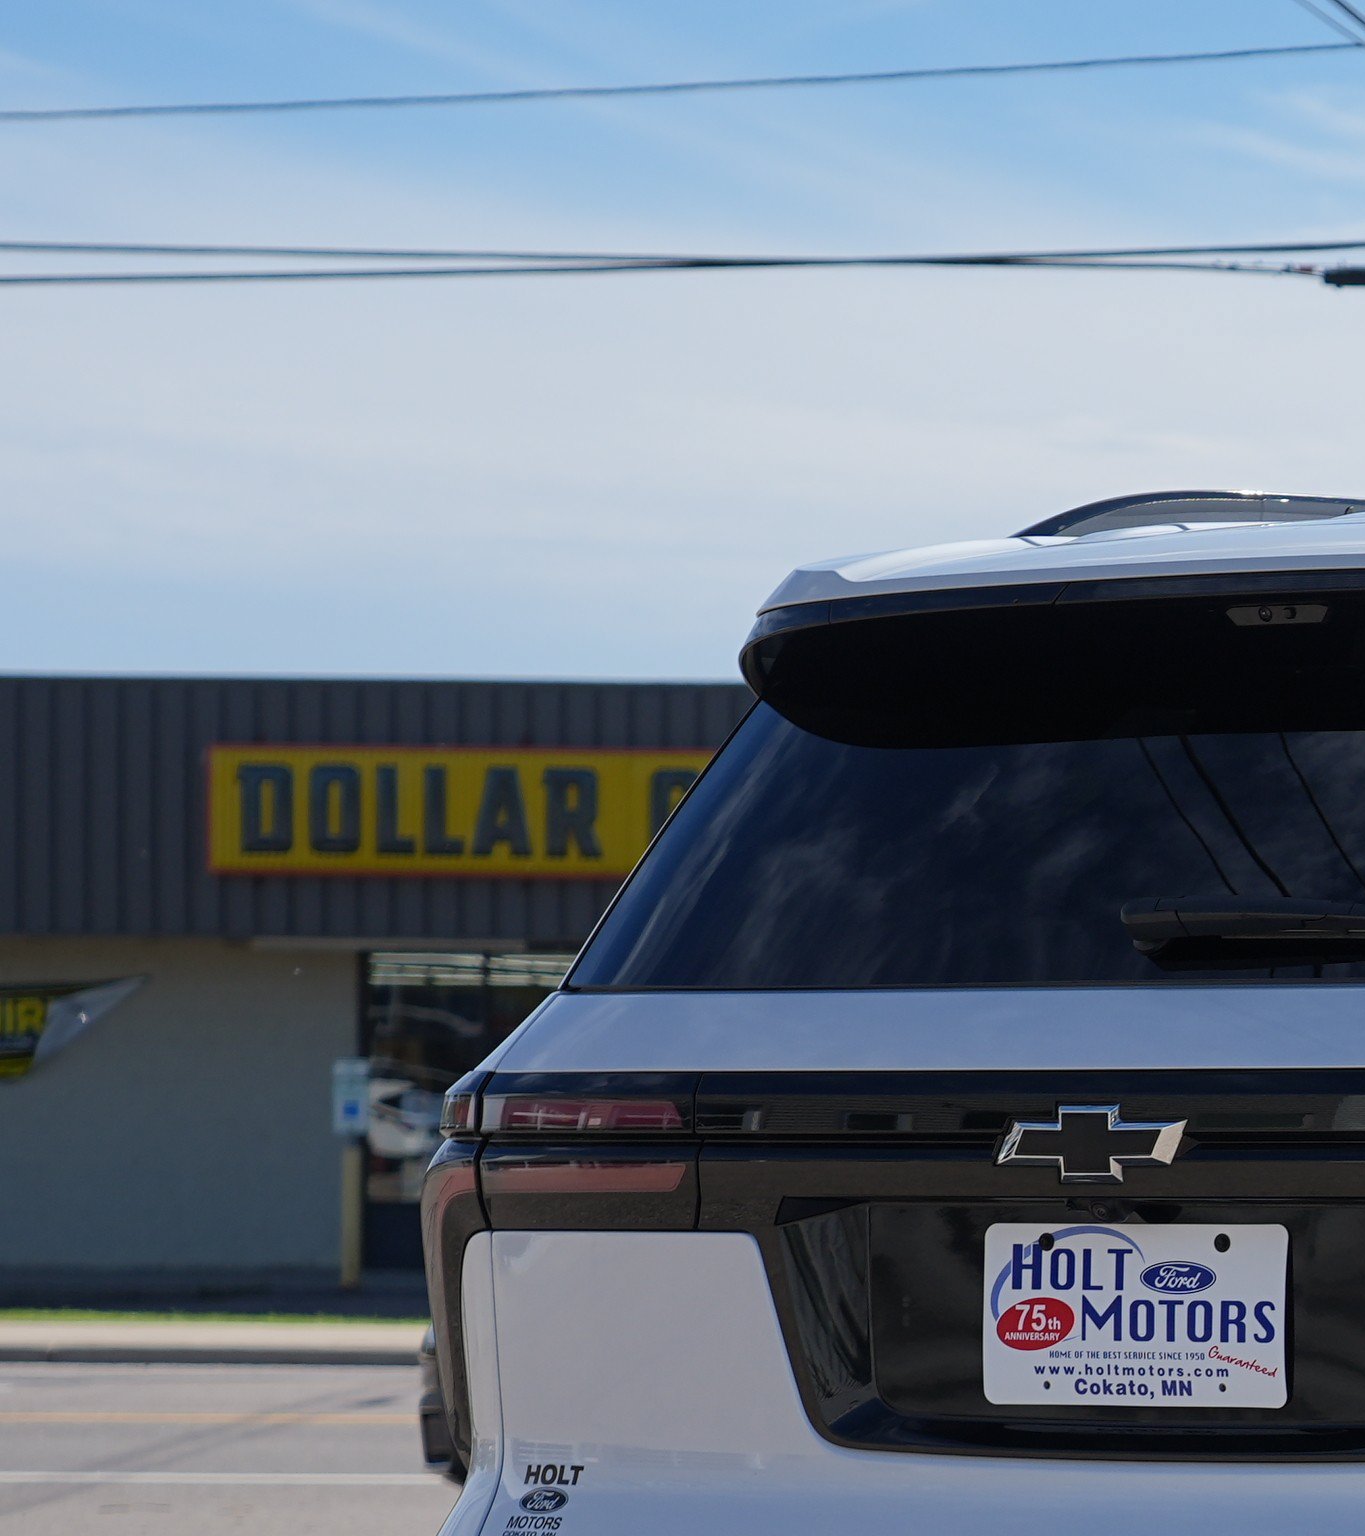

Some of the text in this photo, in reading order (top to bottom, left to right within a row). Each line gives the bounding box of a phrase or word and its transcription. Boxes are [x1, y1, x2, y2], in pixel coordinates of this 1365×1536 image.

[236, 764, 603, 858] DOLLAR
[1012, 1243, 1133, 1291] HOLT
[1151, 1263, 1204, 1291] Ford
[1015, 1304, 1061, 1331] 75th
[1081, 1295, 1275, 1343] MOTORS
[1004, 1331, 1060, 1342] ANNIVERSARY
[1049, 1350, 1205, 1361] HOME OF THE BEST SERVICE SINCE 1950
[1208, 1345, 1278, 1378] Guaranteed
[1034, 1363, 1229, 1378] www.holtmotors.com
[1074, 1378, 1193, 1400] Cokato, MN
[524, 1464, 584, 1485] HOLT
[524, 1489, 562, 1511] Ford
[506, 1515, 562, 1530] MOTORS
